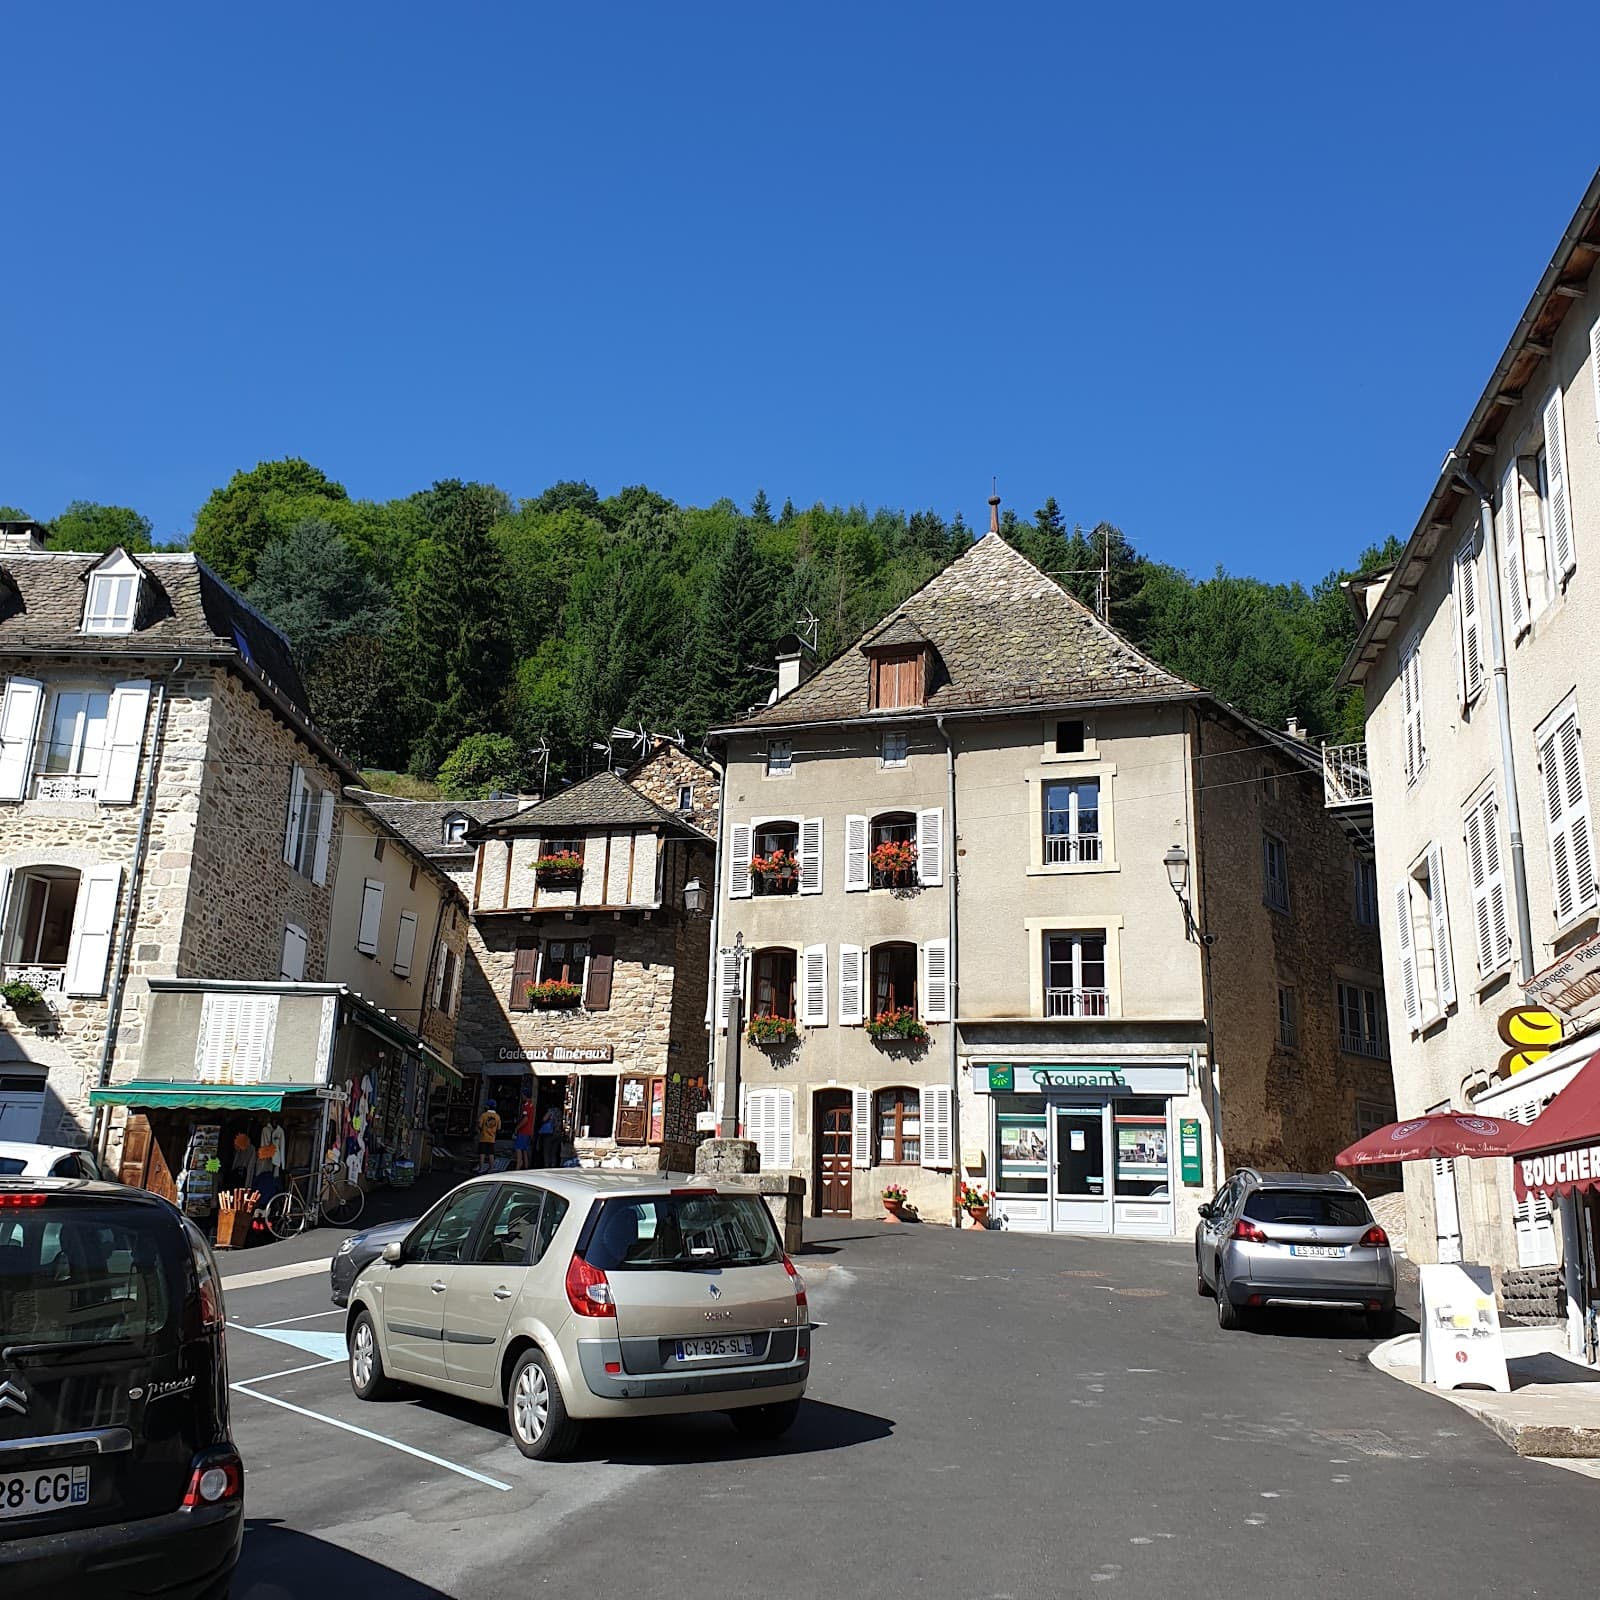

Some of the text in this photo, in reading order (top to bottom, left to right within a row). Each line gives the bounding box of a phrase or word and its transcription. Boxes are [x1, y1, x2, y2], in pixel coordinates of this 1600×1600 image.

[499, 1047, 548, 1060] Cadeaux
[1032, 1071, 1126, 1087] Groupama
[73, 1484, 86, 1499] 15
